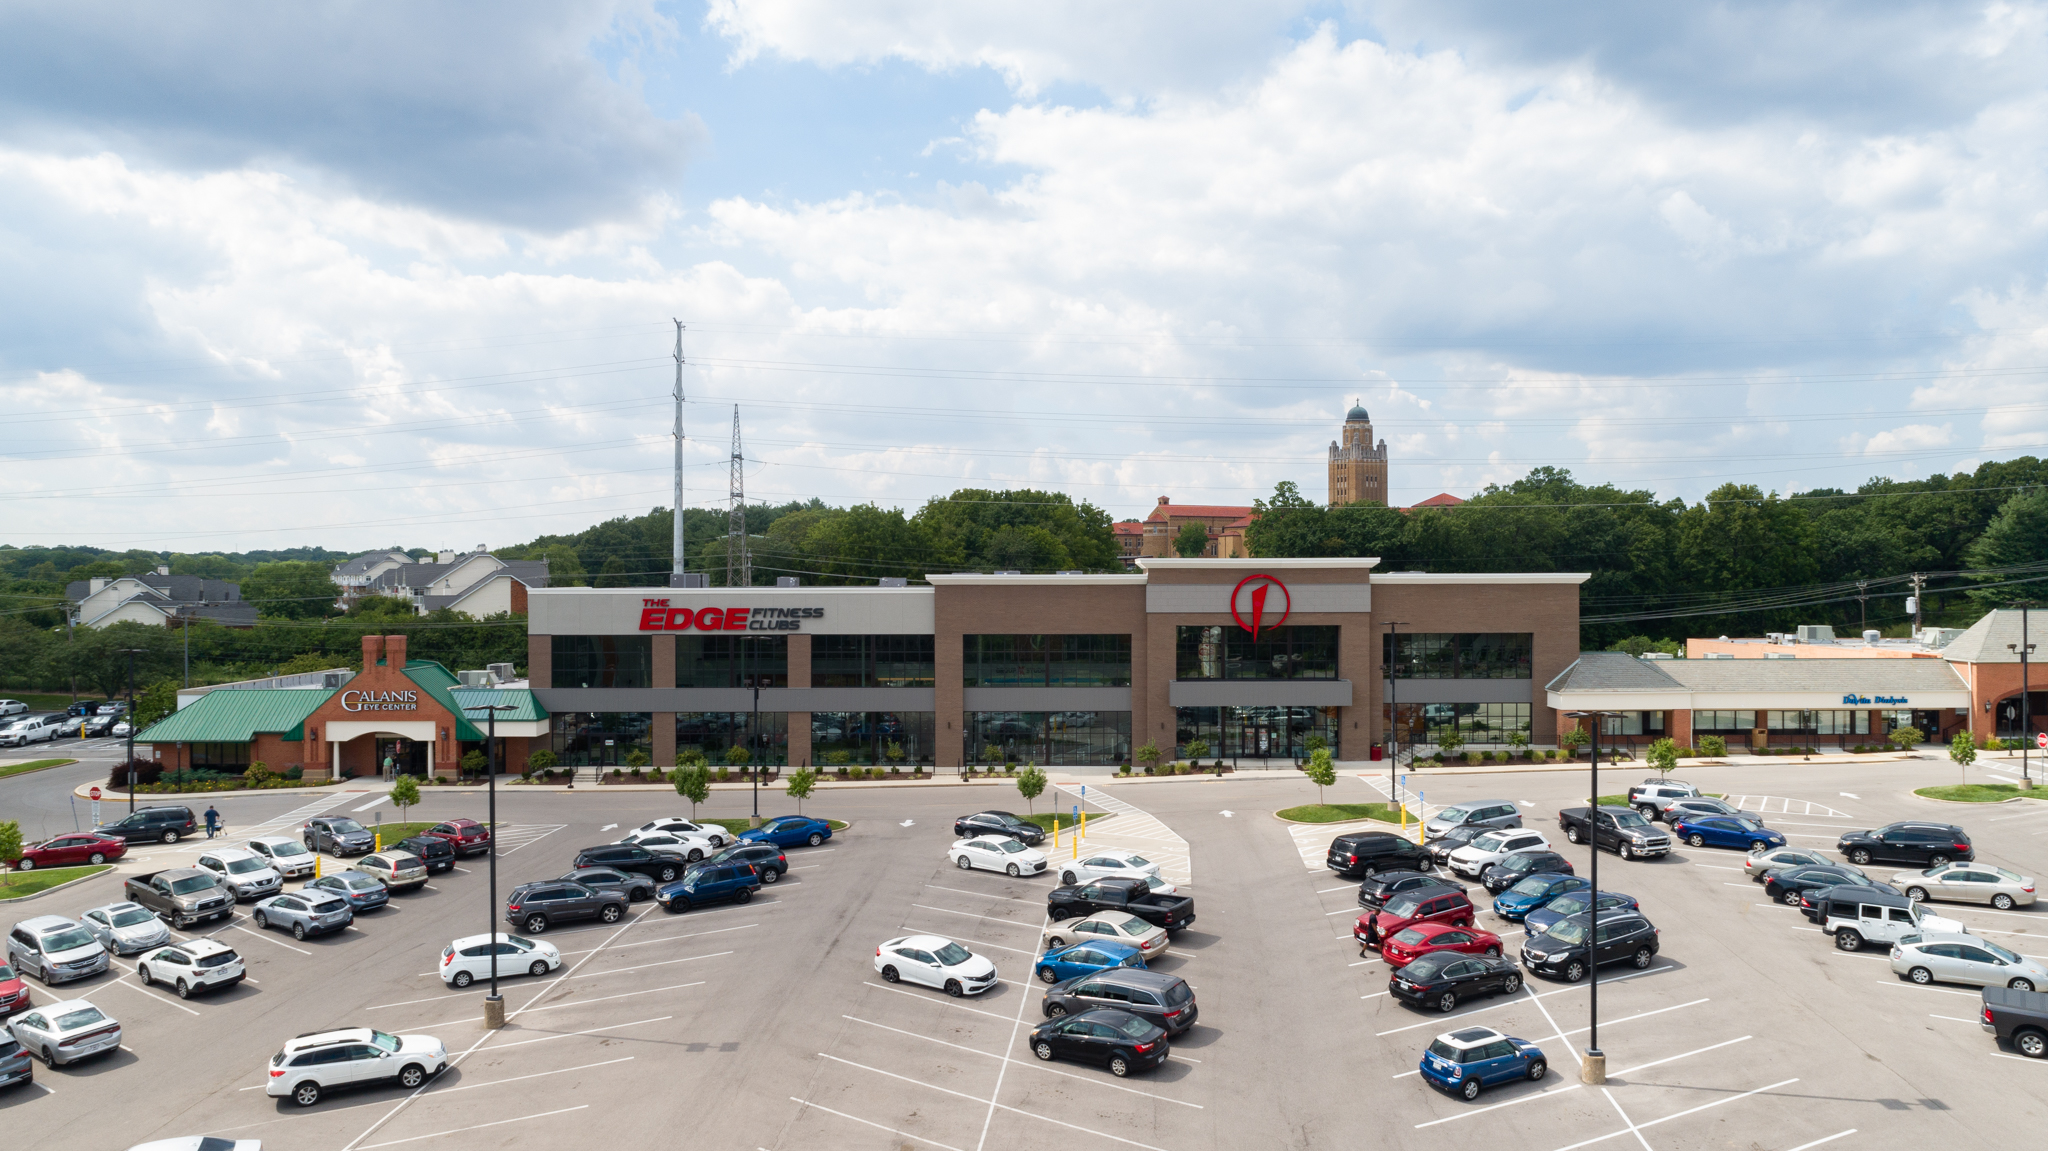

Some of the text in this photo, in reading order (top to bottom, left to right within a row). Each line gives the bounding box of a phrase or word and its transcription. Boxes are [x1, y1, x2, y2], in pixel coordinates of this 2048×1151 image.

[642, 598, 670, 607] THE
[639, 607, 750, 631] EDGE
[752, 607, 824, 619] FITNESS
[749, 620, 800, 631] CLUBS
[341, 690, 417, 712] GALANIS
[1842, 693, 1908, 706] DaVita Dialysis
[364, 703, 417, 711] EYE CENTER
